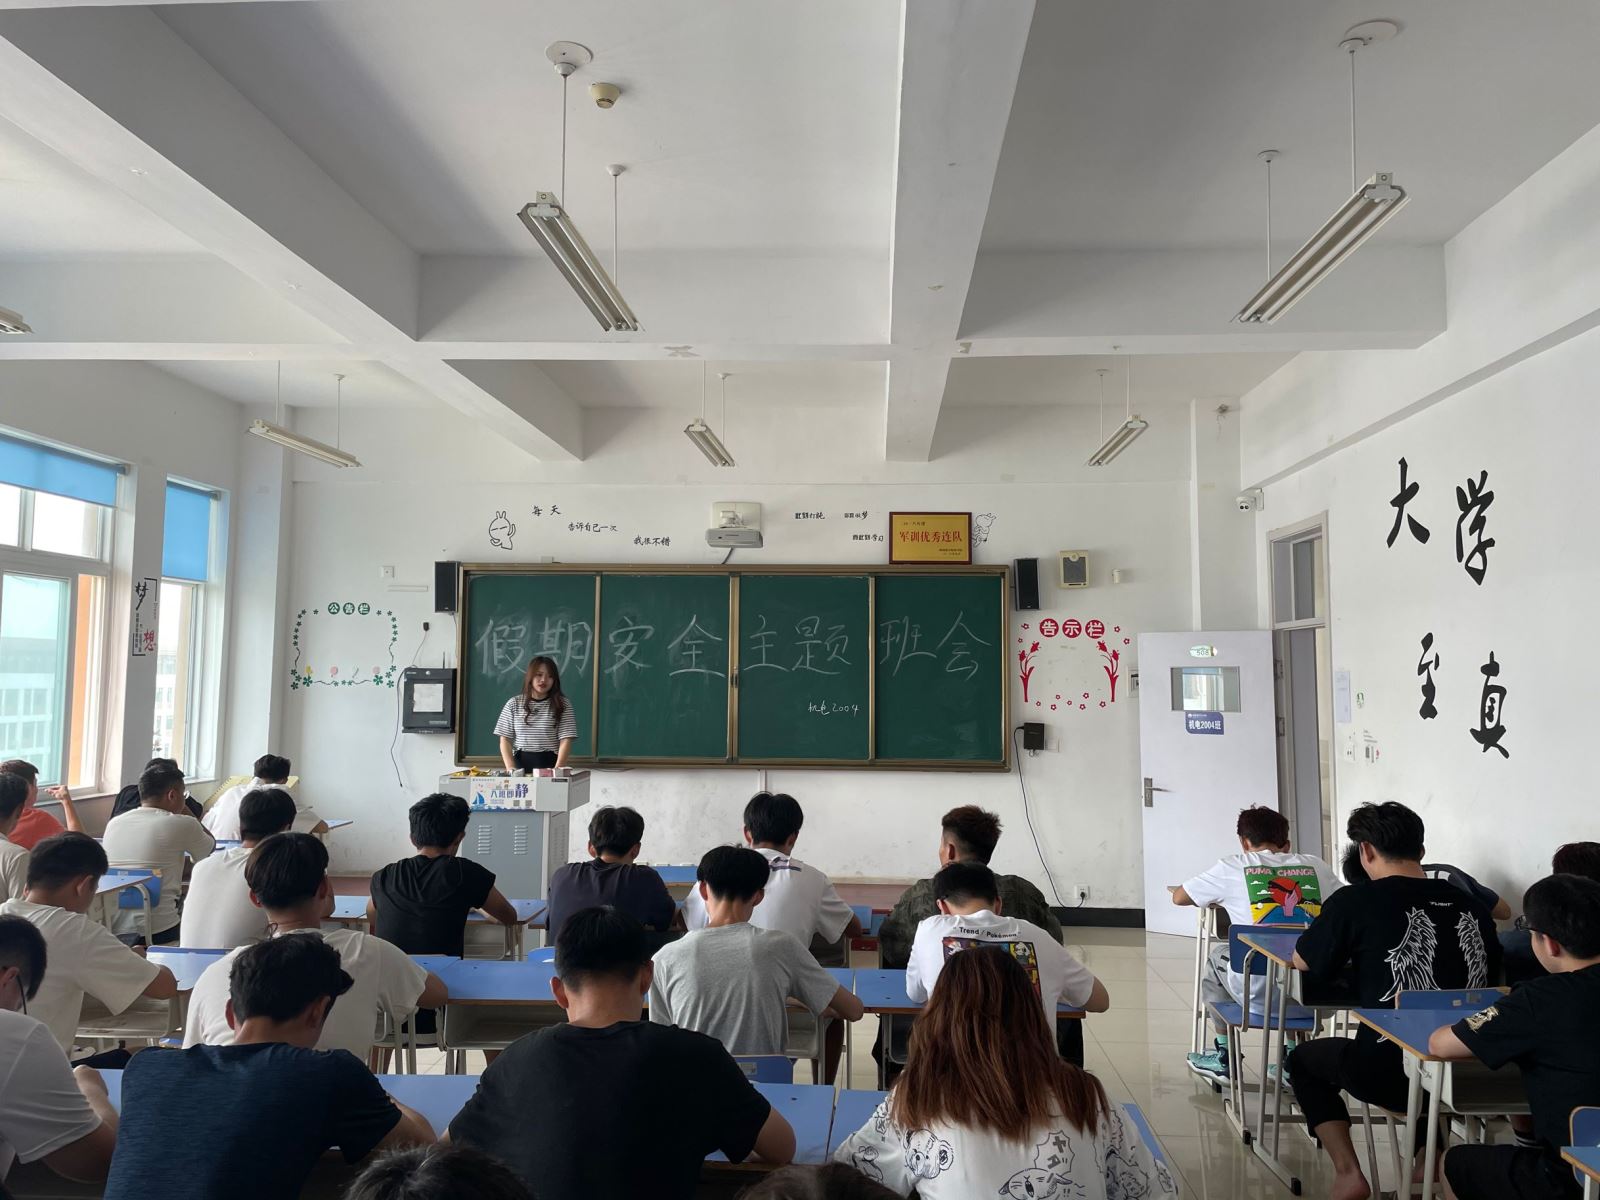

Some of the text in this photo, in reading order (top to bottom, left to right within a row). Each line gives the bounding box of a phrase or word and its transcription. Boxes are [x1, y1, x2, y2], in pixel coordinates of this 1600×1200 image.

[531, 505, 561, 516] 每天
[568, 522, 618, 532] 告诉自己一次
[634, 535, 671, 547] 我很不错
[899, 530, 962, 543] 军训优秀连队
[328, 602, 371, 615] 公告栏
[1041, 619, 1104, 638] 告示栏
[1188, 719, 1222, 730] 机电2004班
[1246, 867, 1315, 876] PUMA CHANGE
[959, 927, 980, 935] Trend
